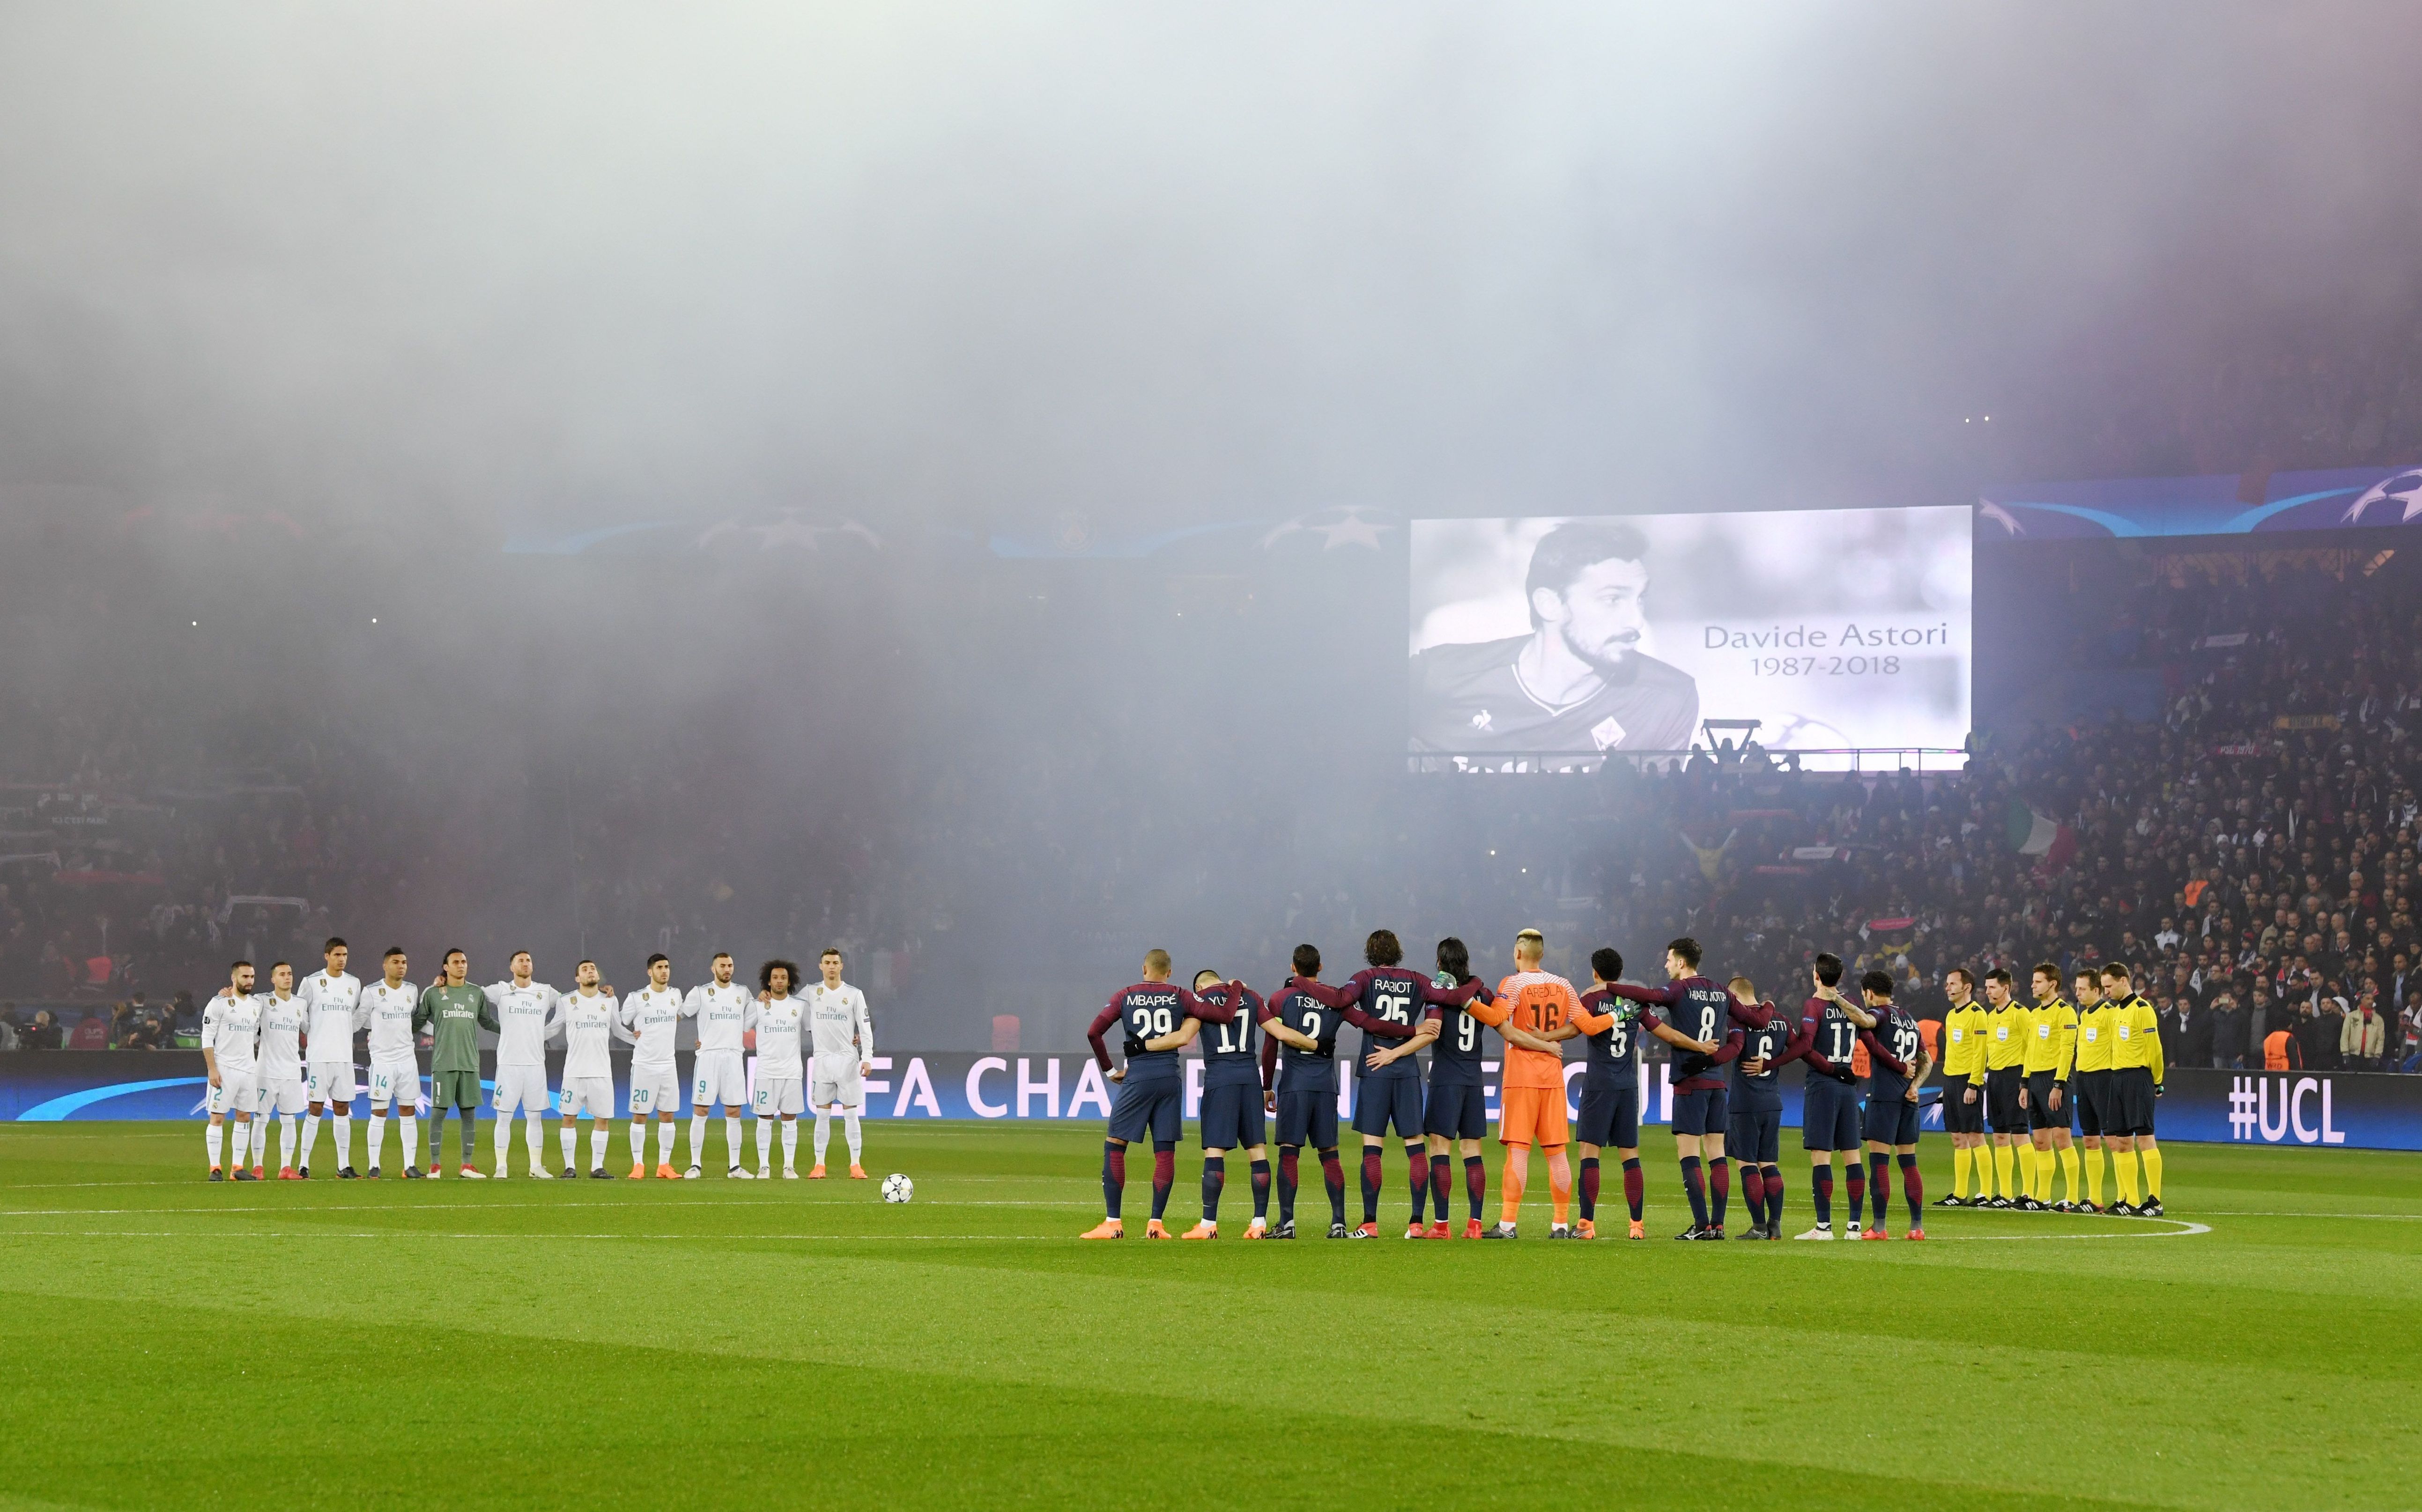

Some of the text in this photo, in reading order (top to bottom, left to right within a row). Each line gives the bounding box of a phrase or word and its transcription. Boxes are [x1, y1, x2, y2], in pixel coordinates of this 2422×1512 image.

[1704, 622, 1948, 649] Davide Astori
[1750, 656, 1901, 676] 1987-2018
[1375, 979, 1412, 993] RABIOT
[333, 997, 343, 1007] Fly
[521, 1001, 532, 1011] Fly
[1126, 993, 1177, 1006] MBAPPÉ
[393, 1005, 404, 1015] Fly
[442, 1010, 474, 1019] Emirates
[454, 1003, 465, 1012] Fly
[656, 1009, 667, 1019] Fly
[721, 1006, 732, 1017] Fly
[826, 1006, 837, 1017] Fly
[382, 1011, 411, 1020] Emirate
[587, 1014, 597, 1025] Fly
[644, 1015, 675, 1025] Emirates
[710, 1012, 741, 1020] Emirates
[816, 1012, 848, 1021] Emirates
[1375, 994, 1410, 1040] 25
[1530, 1003, 1559, 1033] 16
[269, 1021, 299, 1032] Emirate
[776, 1019, 786, 1029] Fly
[1133, 1008, 1172, 1040] 29
[1217, 1008, 1249, 1054] 17
[1458, 1010, 1475, 1052] 9
[1698, 1006, 1715, 1044] 8
[1300, 1011, 1321, 1055] 2
[1610, 1021, 1627, 1058] 5
[1827, 1022, 1856, 1063] 11
[1890, 1028, 1918, 1063] 32
[1756, 1035, 1773, 1077] 6
[309, 1076, 317, 1089] 5
[376, 1074, 387, 1090] 14
[436, 1082, 441, 1096] 1
[699, 1080, 706, 1093] 9
[214, 1088, 222, 1101] 2
[496, 1084, 503, 1098] 4
[560, 1088, 573, 1104] 23
[633, 1089, 648, 1103] 20
[756, 1090, 768, 1105] 12
[2229, 1076, 2346, 1144] #UCL
